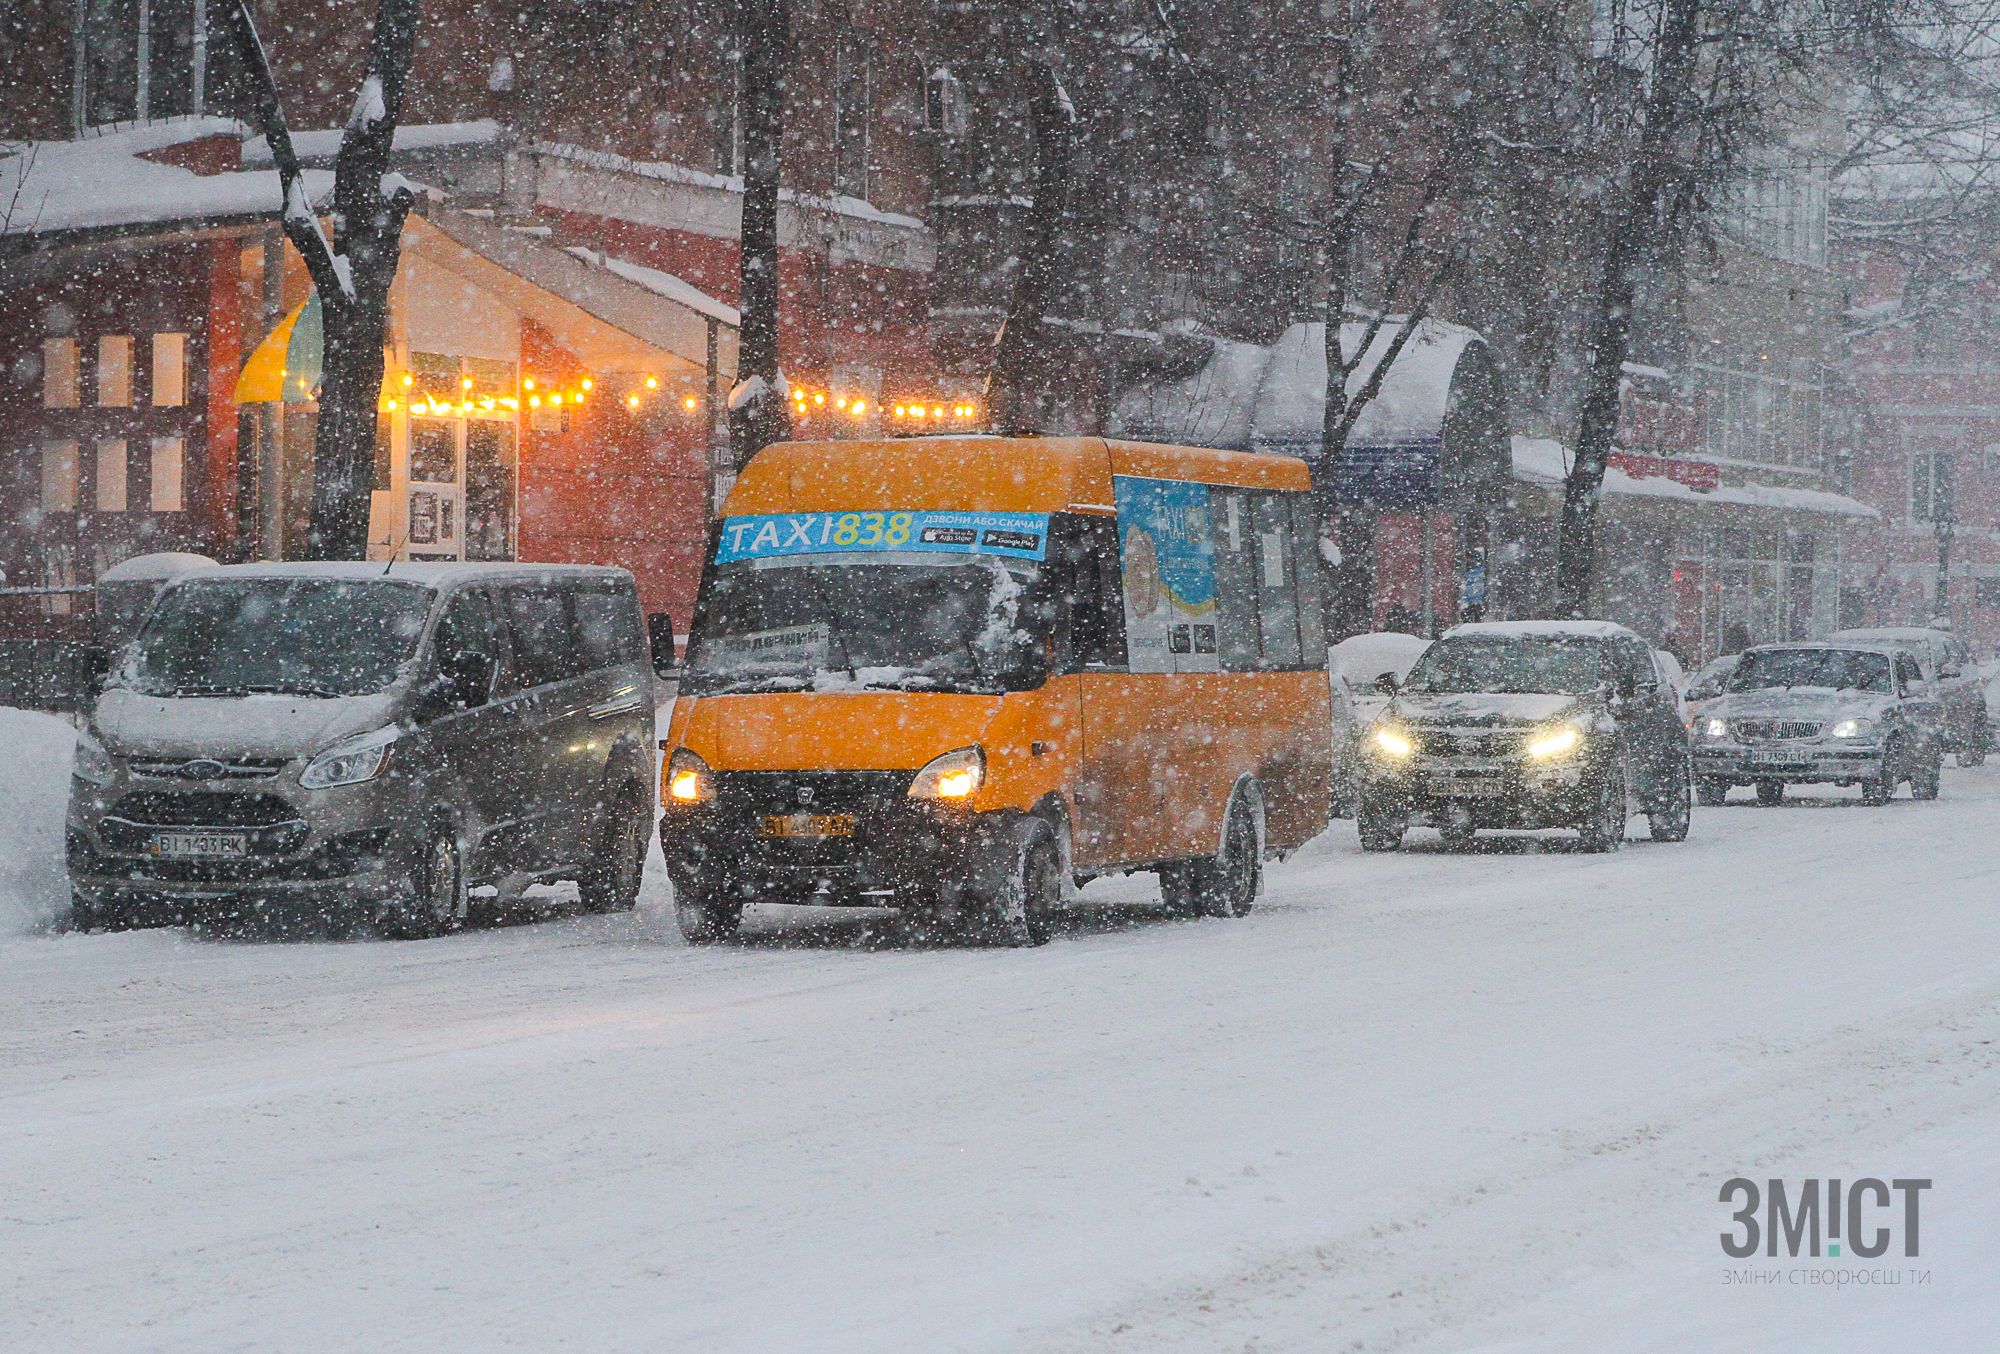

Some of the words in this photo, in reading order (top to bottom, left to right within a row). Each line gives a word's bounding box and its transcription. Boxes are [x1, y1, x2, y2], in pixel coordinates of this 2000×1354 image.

[922, 514, 971, 525] ДЗВОНИ
[973, 516, 996, 526] АБО
[999, 518, 1044, 530] СКАЧАЙ
[998, 537, 1020, 546] Google
[1021, 539, 1035, 548] Play
[160, 836, 177, 852] BI
[221, 836, 242, 853] BK
